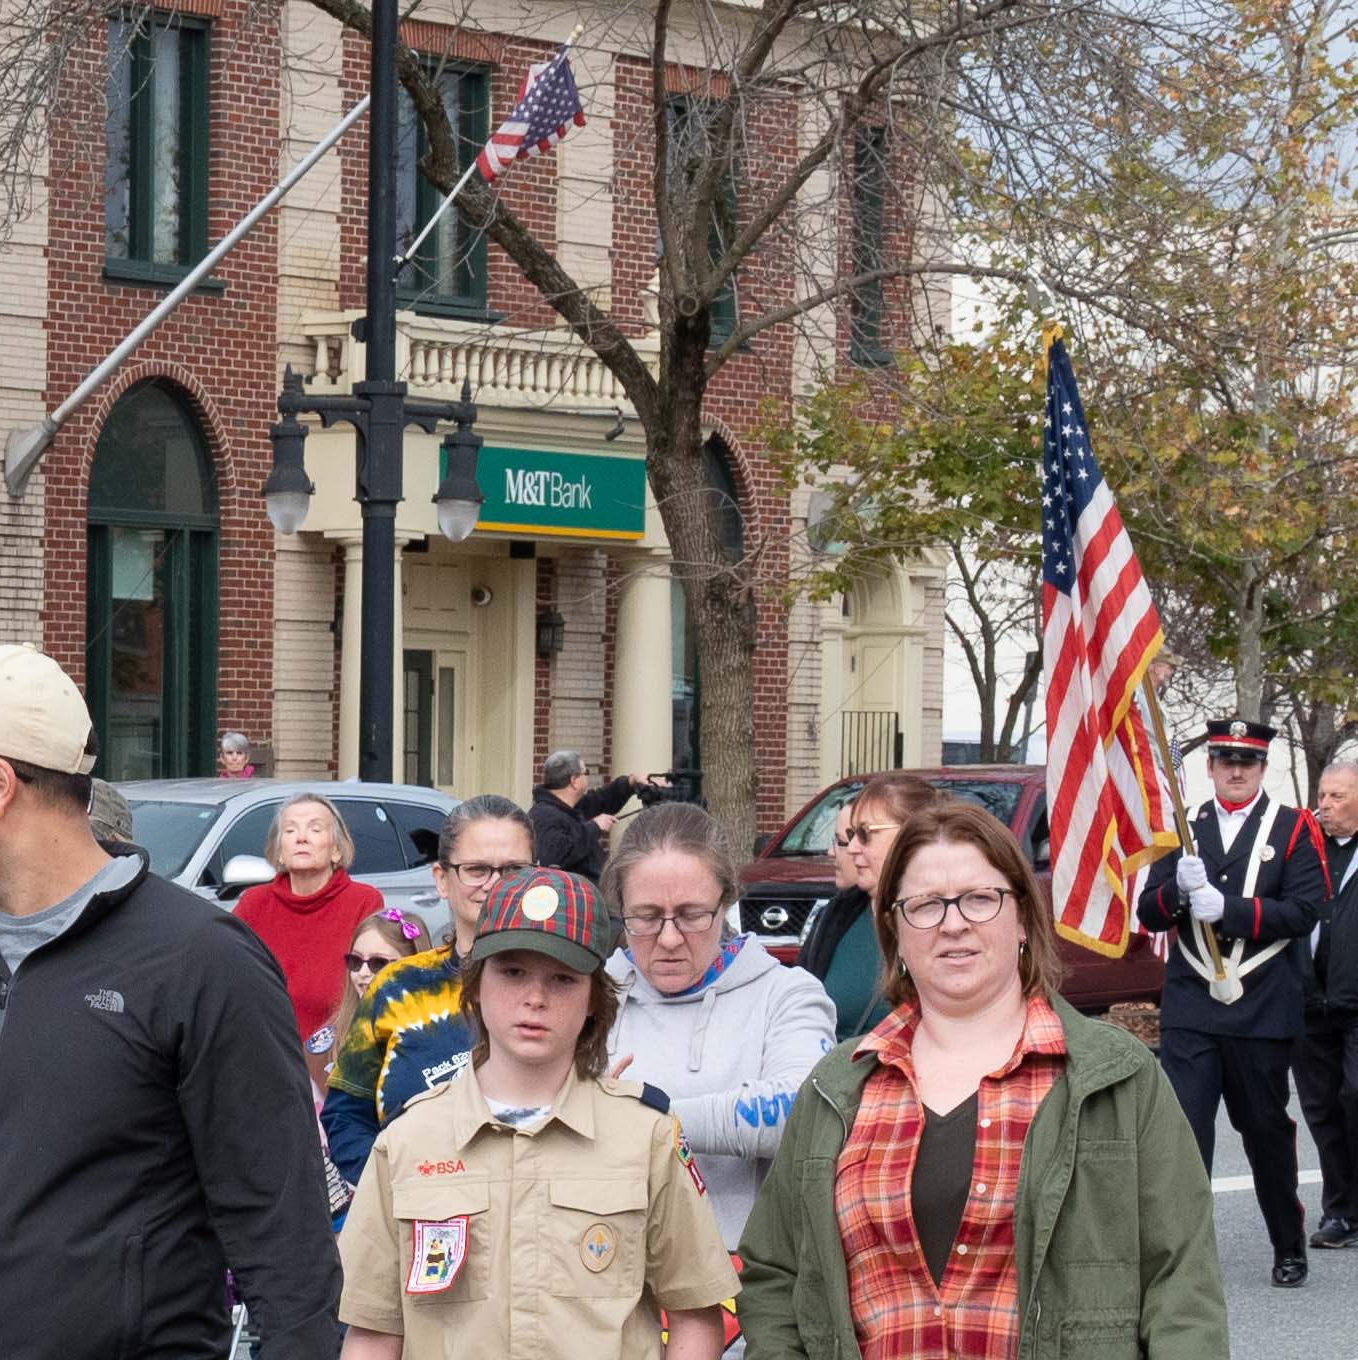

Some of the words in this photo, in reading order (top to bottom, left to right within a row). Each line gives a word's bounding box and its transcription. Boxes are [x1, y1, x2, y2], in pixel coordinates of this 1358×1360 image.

[504, 468, 550, 506] M&T
[550, 471, 592, 510] Bank
[436, 1159, 466, 1174] BSA
